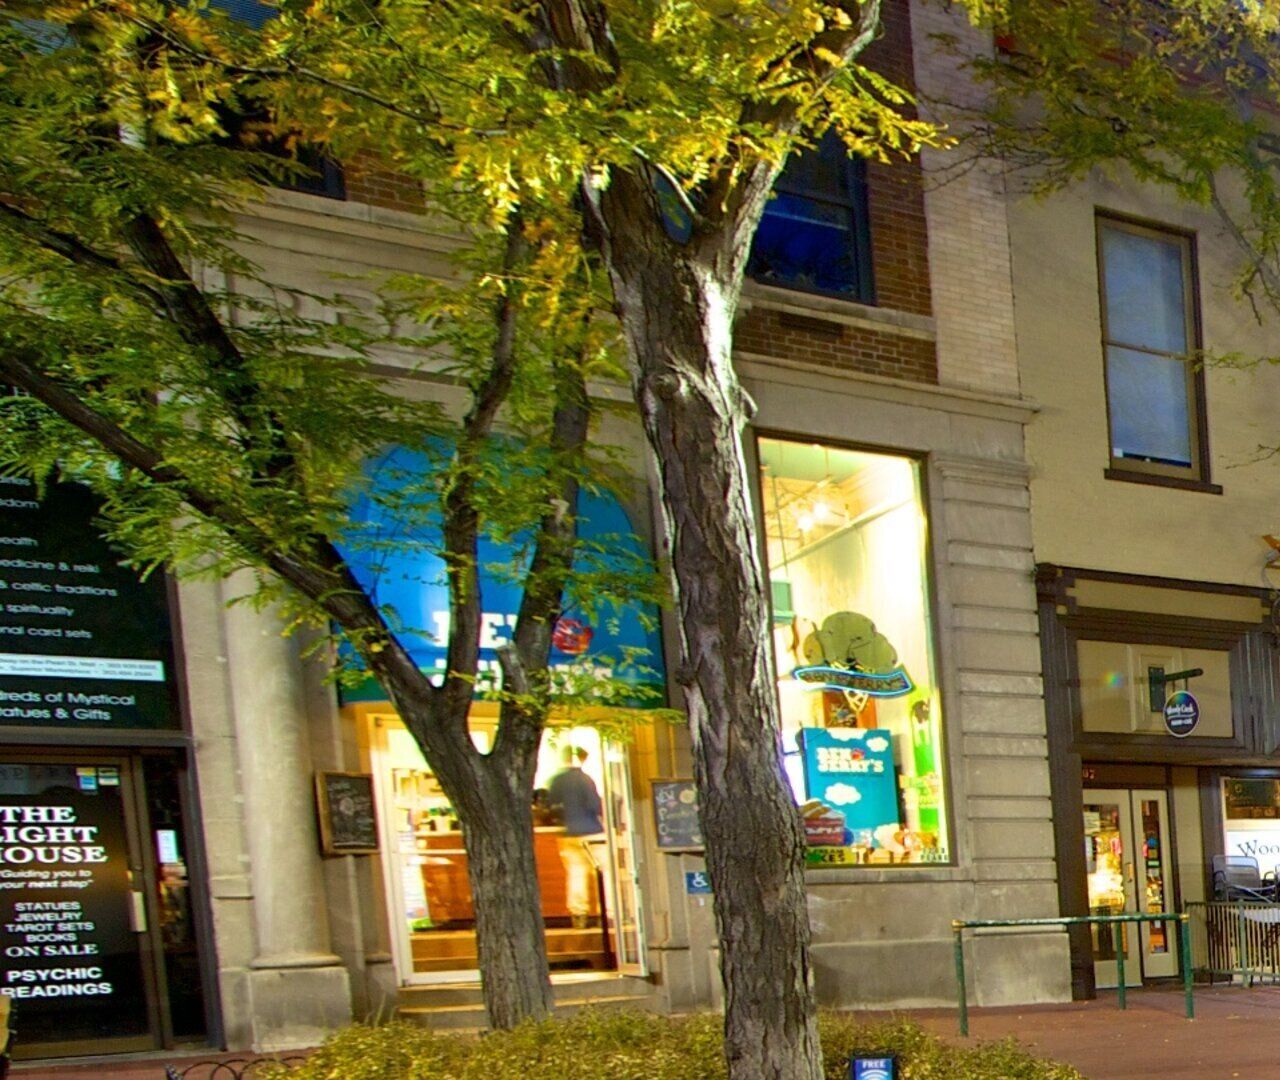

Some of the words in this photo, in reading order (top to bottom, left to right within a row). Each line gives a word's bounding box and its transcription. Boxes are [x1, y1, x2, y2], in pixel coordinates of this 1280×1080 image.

[0, 536, 39, 547] ealth
[0, 559, 55, 570] edicine
[59, 562, 70, 571] &
[11, 582, 52, 592] celtic
[54, 584, 118, 597] traditions
[27, 627, 63, 636] card
[65, 630, 93, 639] sets
[44, 692, 63, 703] of
[66, 692, 135, 706] Mystical
[54, 707, 69, 719] &
[72, 708, 111, 720] Gifts
[815, 748, 851, 761] BEN
[816, 759, 884, 773] JERRY'S
[0, 806, 76, 823] THE
[52, 870, 76, 879] you
[15, 902, 81, 911] STATUES
[14, 912, 83, 921] JEWELRY
[5, 923, 54, 932] TAROT
[57, 922, 94, 931] SETS
[26, 933, 77, 942] BOOKS
[5, 946, 39, 957] ON
[44, 944, 98, 956] SALE
[7, 967, 102, 982] PSYCHIC
[0, 983, 112, 998] READINGS
[862, 1060, 886, 1068] FREE
